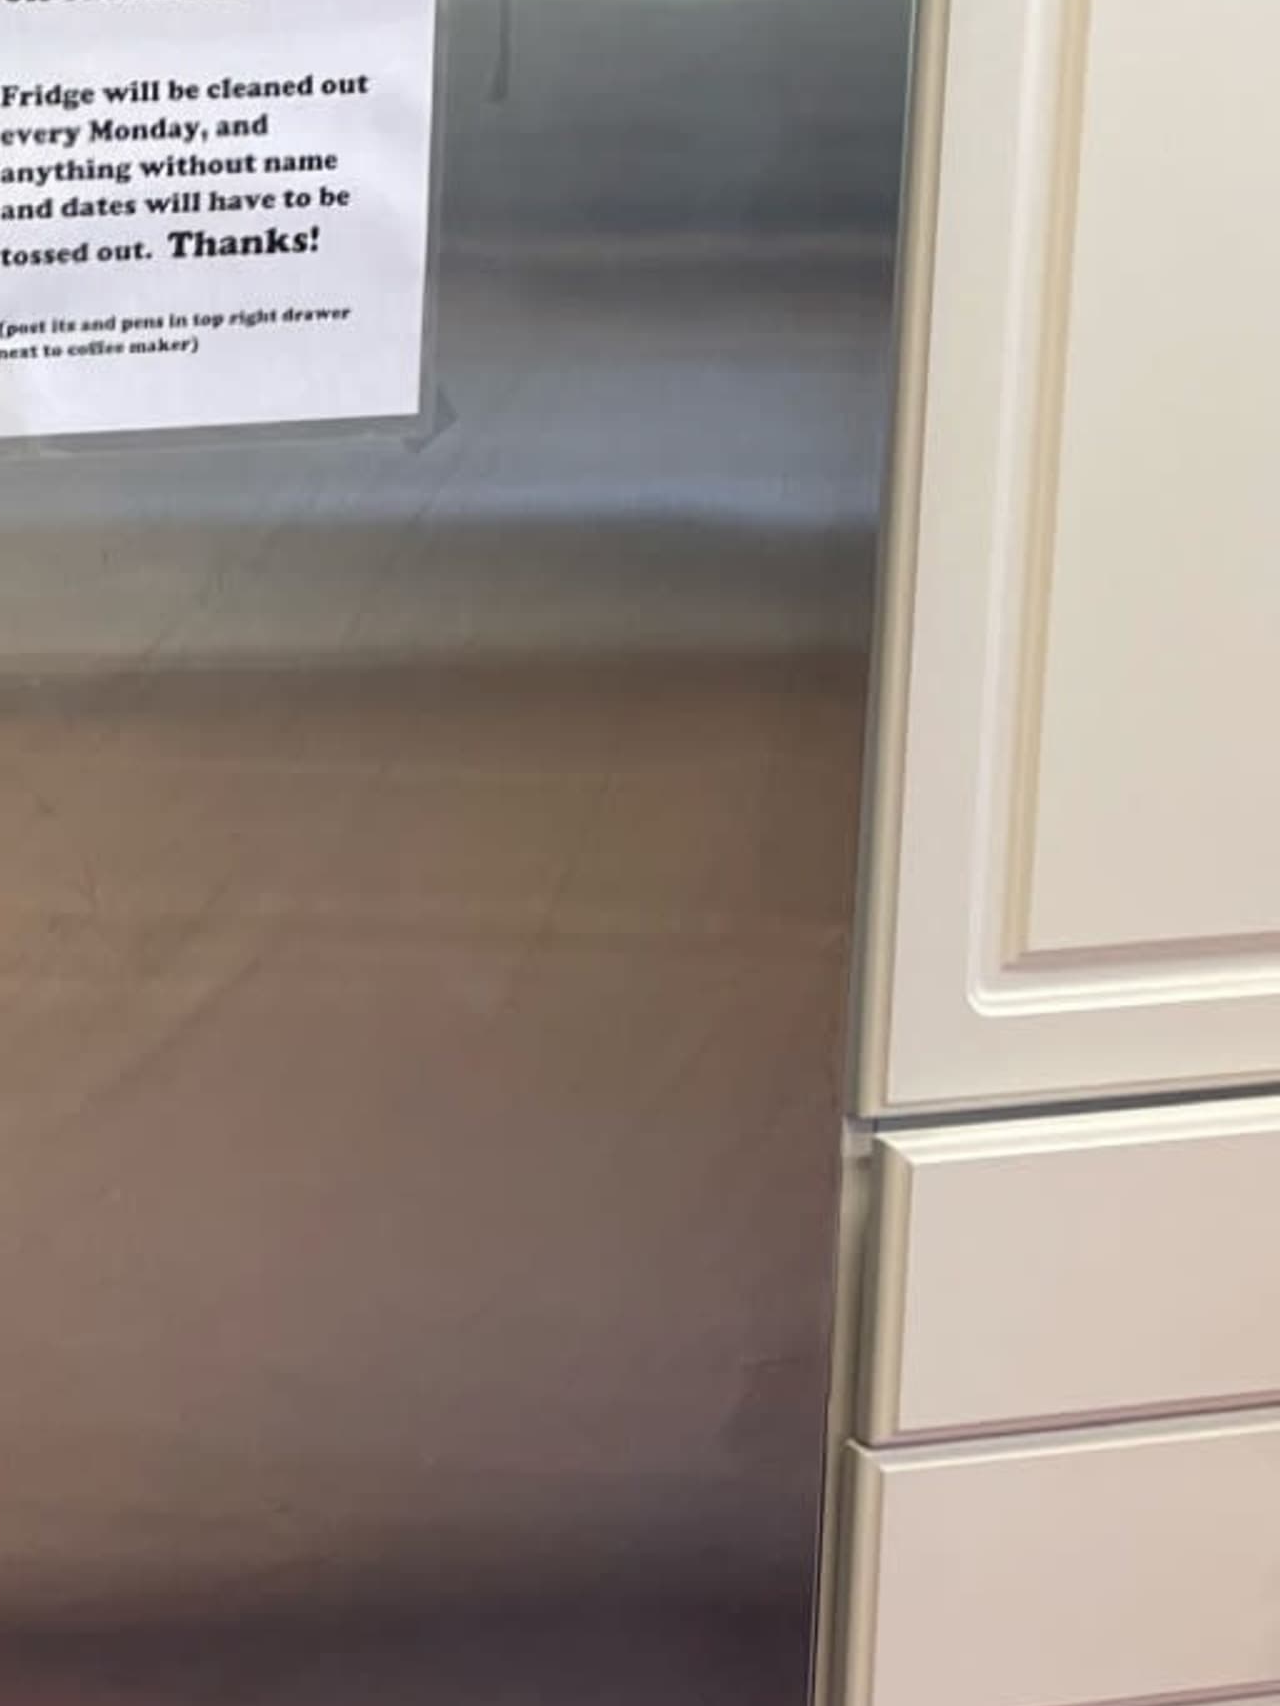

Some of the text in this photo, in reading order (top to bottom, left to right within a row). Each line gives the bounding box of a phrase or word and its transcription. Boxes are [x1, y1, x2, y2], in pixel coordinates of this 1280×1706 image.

[0, 74, 369, 111] Fridge will be cleaned out
[0, 112, 269, 149] every Monday, and
[0, 154, 338, 188] anything without name
[0, 185, 351, 221] and dates will have to be
[0, 225, 320, 268] tossed out. Thanks!
[51, 318, 77, 334] its
[80, 314, 117, 332] and
[121, 316, 165, 334] pens
[168, 313, 189, 329] in
[192, 313, 225, 330] top
[228, 308, 278, 328] right
[281, 307, 351, 323] drawer
[42, 344, 64, 359] to
[66, 339, 125, 357] coffee
[128, 336, 199, 354] maker)
